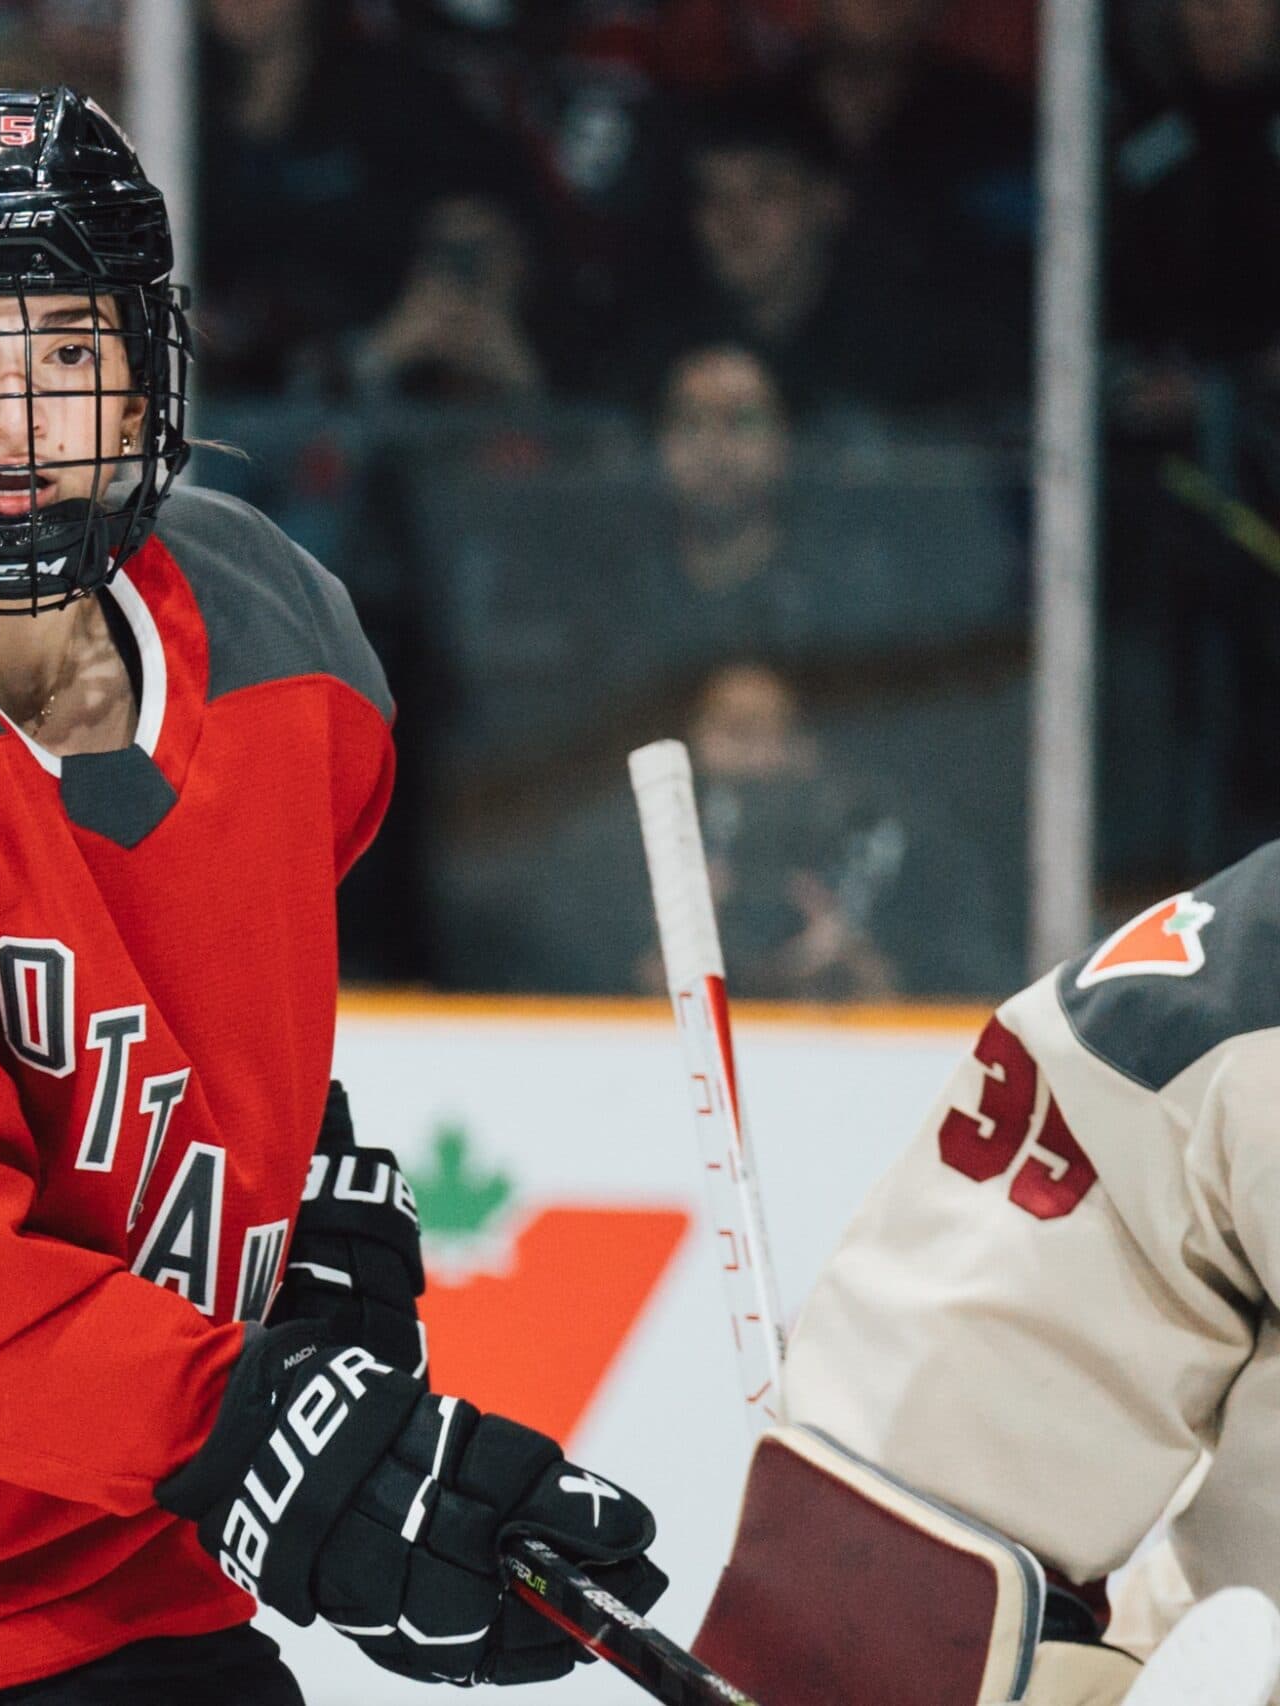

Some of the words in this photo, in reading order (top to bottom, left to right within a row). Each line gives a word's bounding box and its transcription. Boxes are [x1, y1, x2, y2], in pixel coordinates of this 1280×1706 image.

[938, 1014, 1099, 1221] 35
[283, 1343, 318, 1371] MACH
[219, 1346, 395, 1602] BAUER
